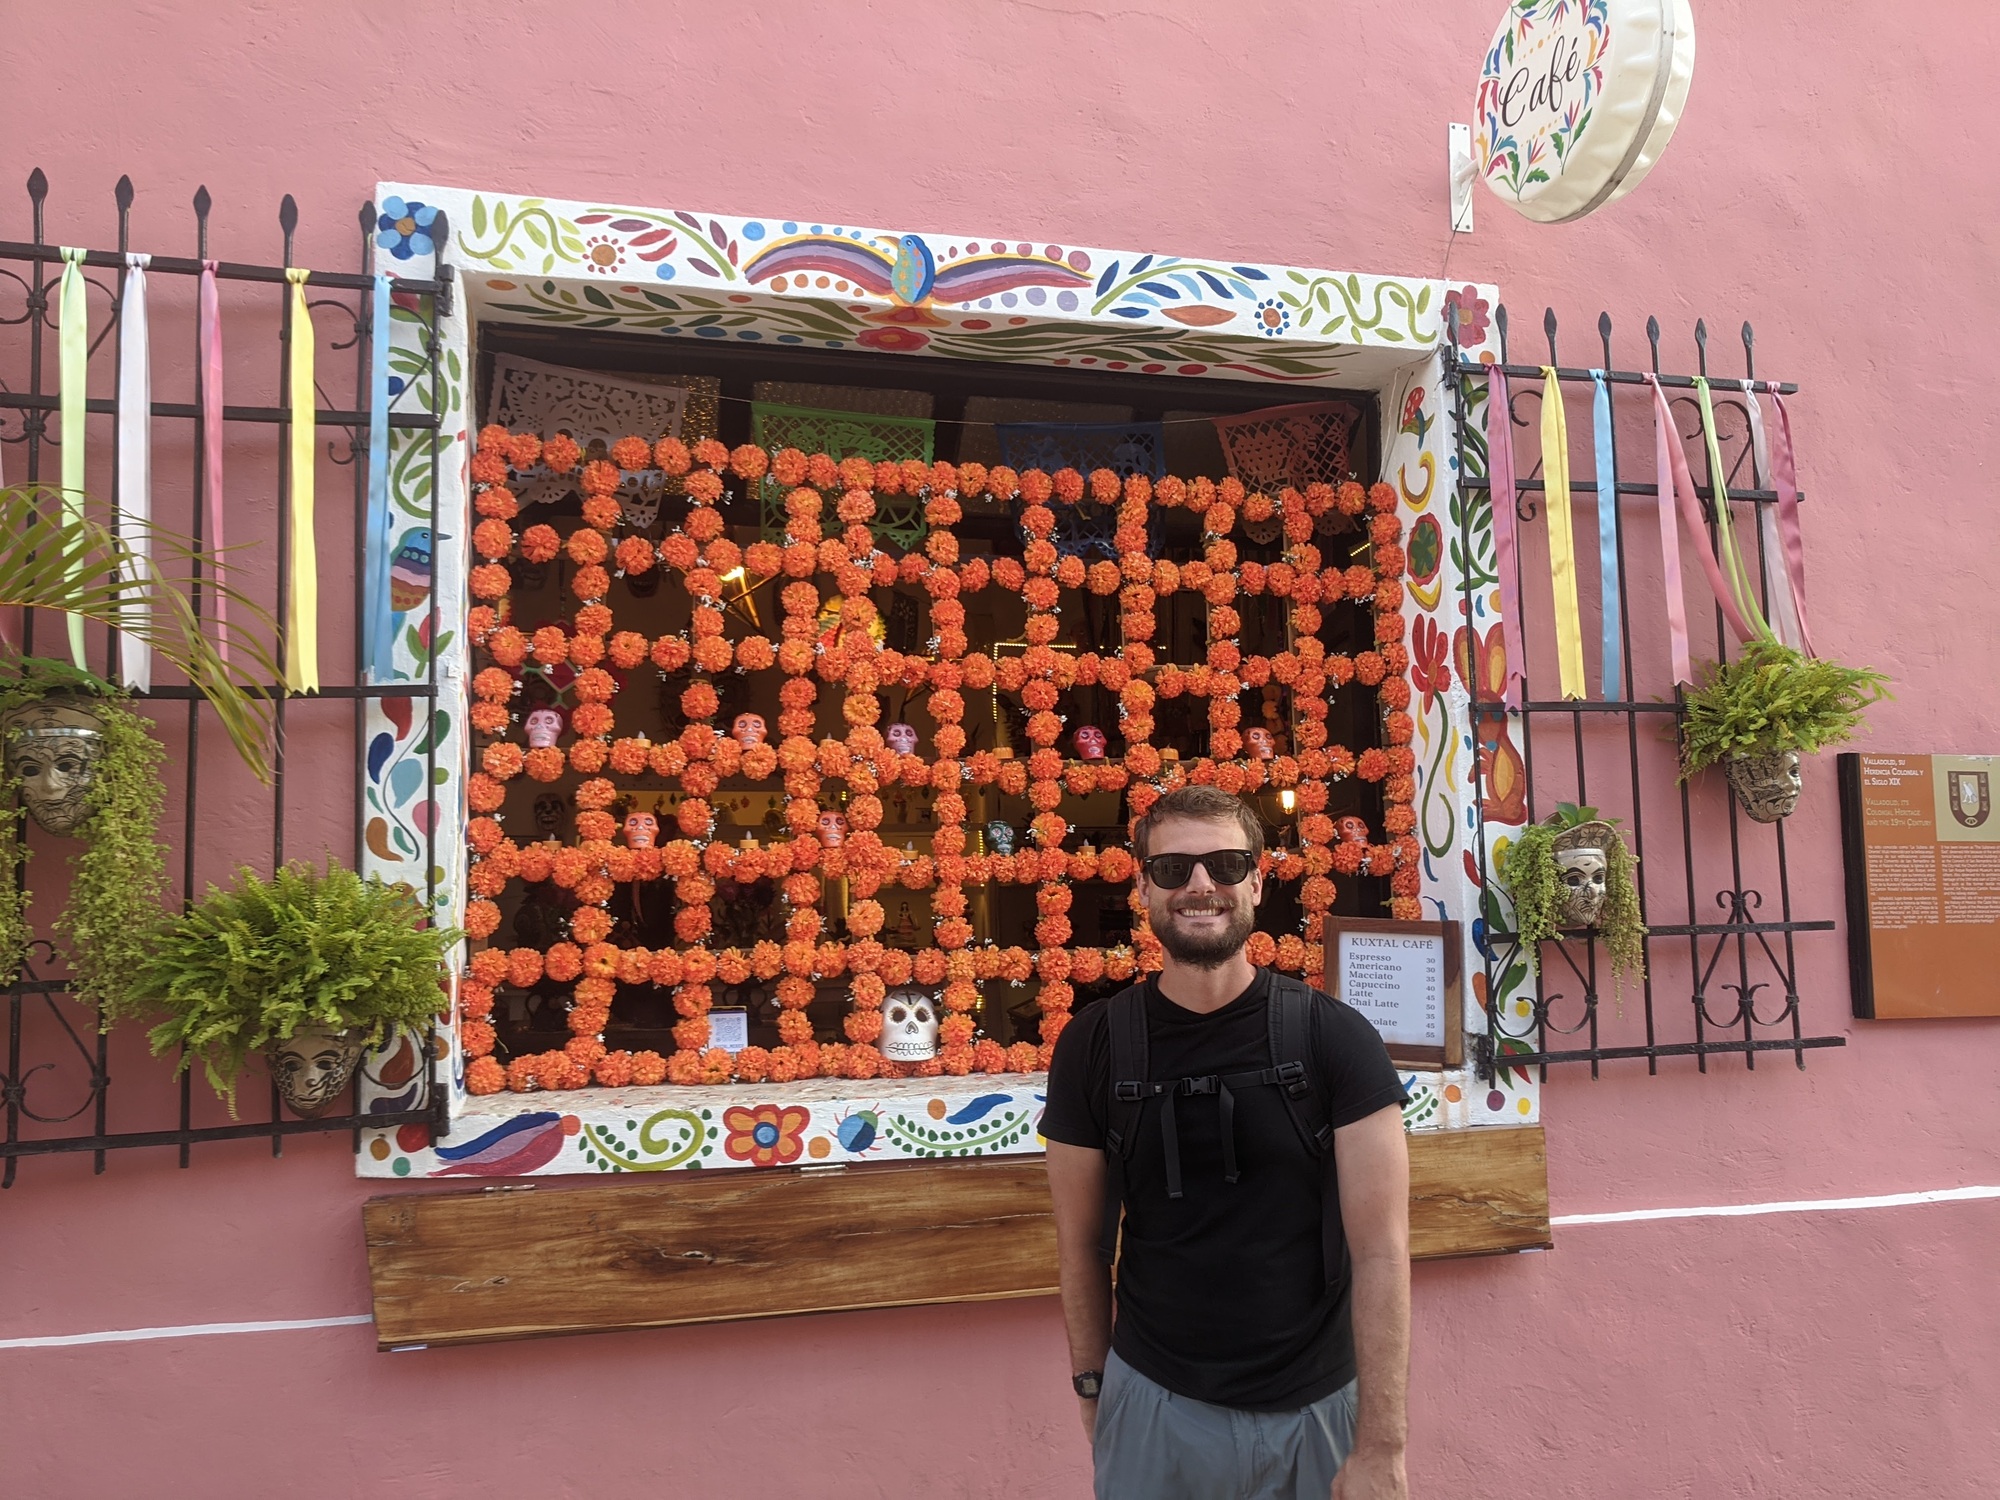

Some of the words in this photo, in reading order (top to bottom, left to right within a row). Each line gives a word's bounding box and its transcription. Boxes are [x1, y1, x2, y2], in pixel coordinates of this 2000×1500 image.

[1498, 35, 1581, 127] Café
[1888, 777, 1901, 786] XIX
[1351, 937, 1399, 948] KUXTAL
[1402, 939, 1434, 950] CAFÉ
[1349, 952, 1392, 962] Espresso
[1349, 962, 1402, 972] Americano
[1349, 971, 1393, 980] Macciato
[1349, 979, 1401, 990] Capuccino
[1349, 989, 1373, 998] Latte
[1348, 997, 1371, 1007] Chai
[1374, 999, 1399, 1009] Latte
